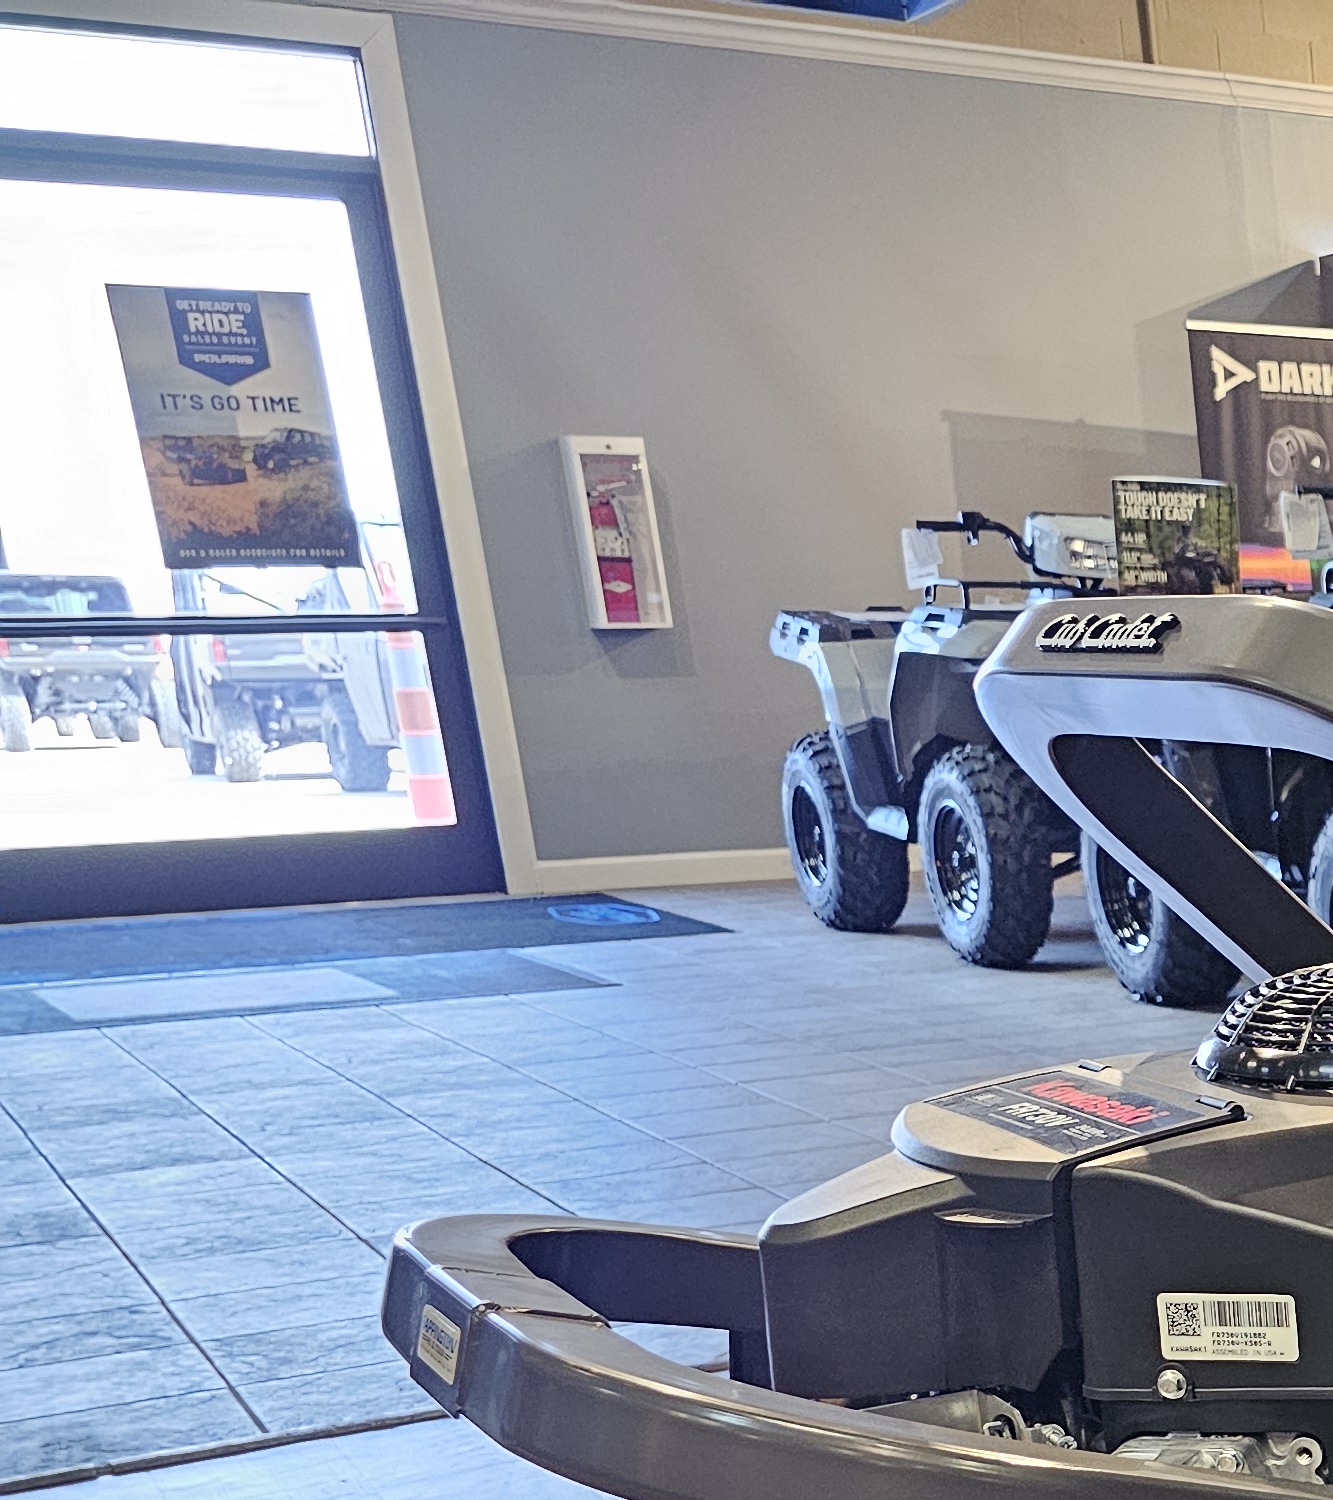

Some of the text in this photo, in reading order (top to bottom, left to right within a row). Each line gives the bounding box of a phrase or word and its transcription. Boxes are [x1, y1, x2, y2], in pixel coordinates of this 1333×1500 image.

[160, 392, 302, 414] IT'S GO TIME
[1119, 490, 1207, 509] TOUGH DOESN'T
[1118, 505, 1195, 522] TAKE IT EASY
[1035, 613, 1180, 650] Cub Cadet
[1211, 1348, 1249, 1356] ASSEMBLED
